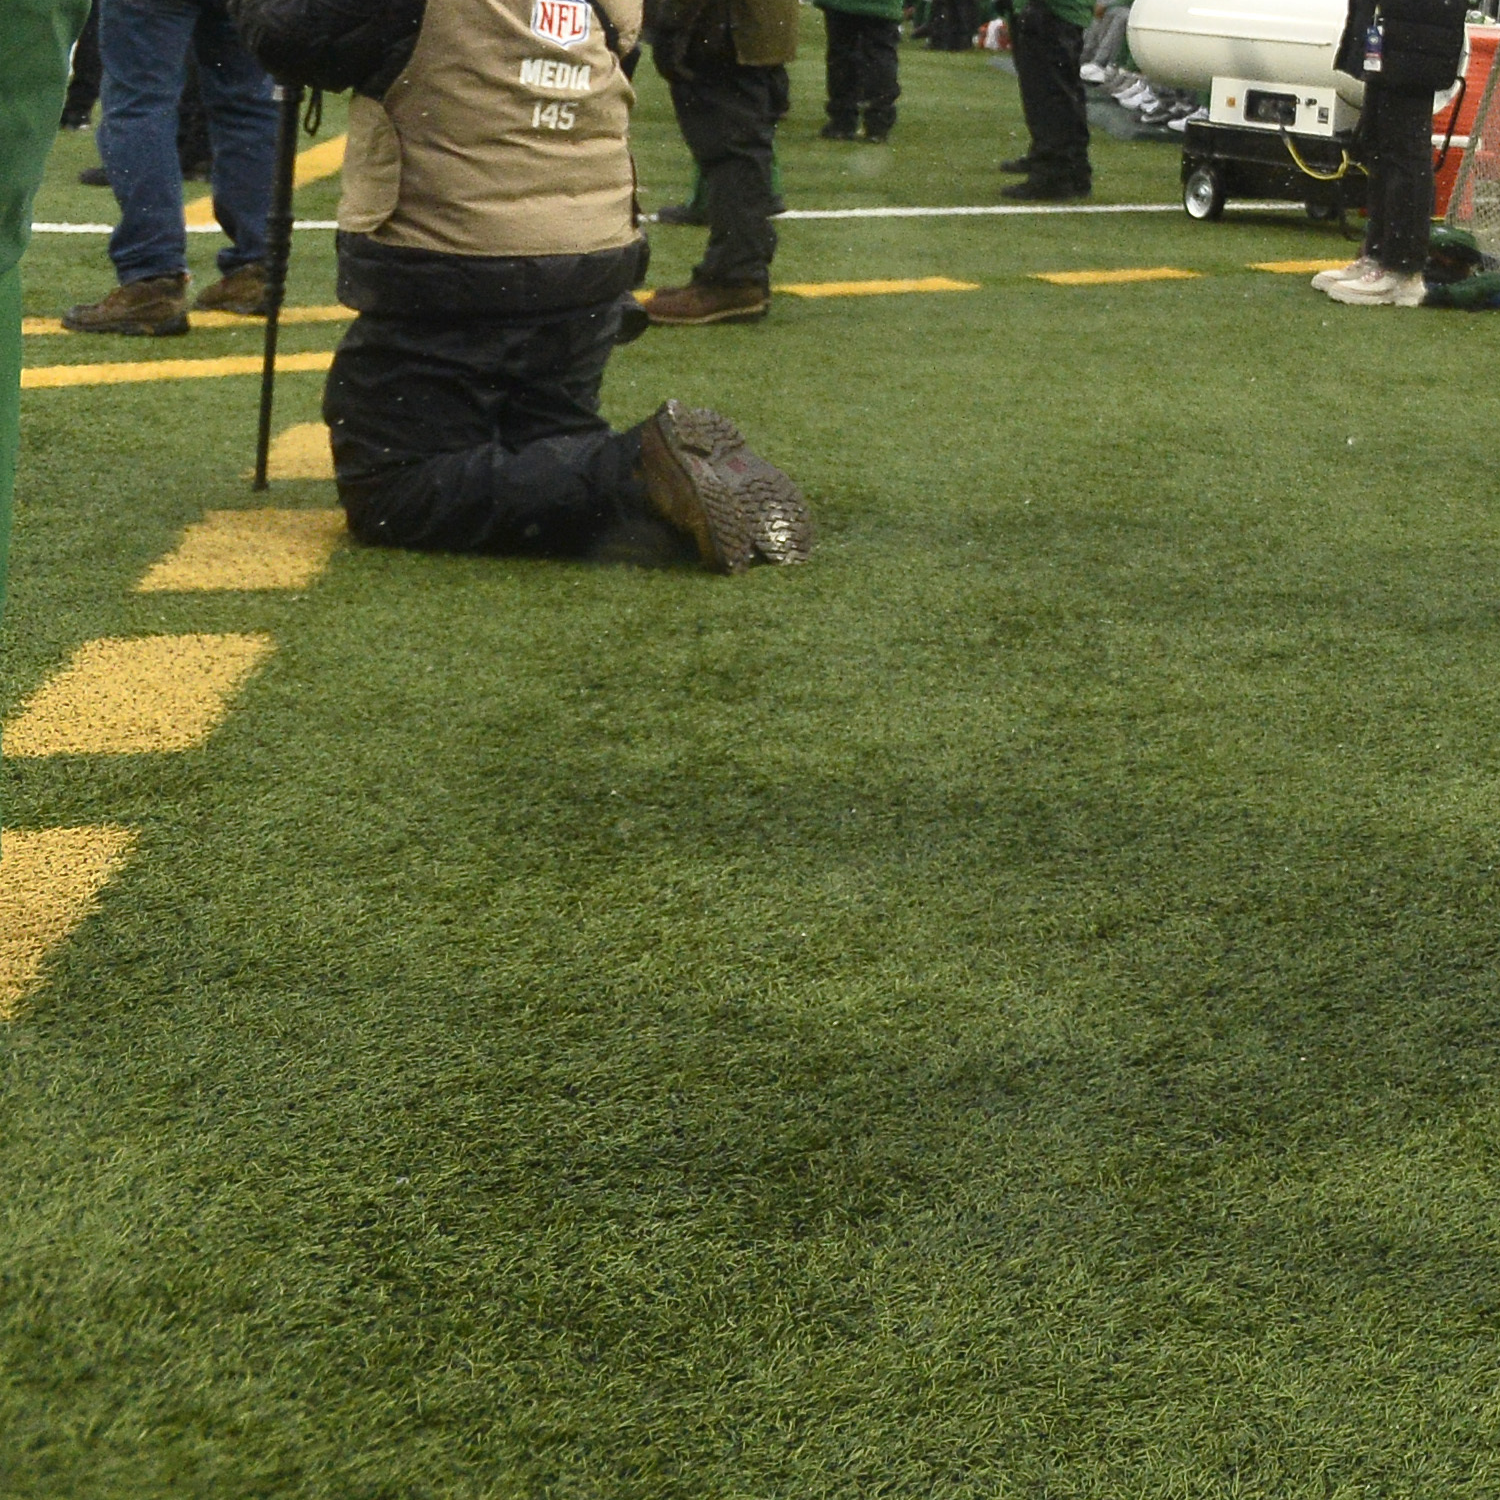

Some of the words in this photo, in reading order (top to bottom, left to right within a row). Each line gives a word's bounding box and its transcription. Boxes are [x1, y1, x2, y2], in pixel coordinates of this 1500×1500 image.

[540, 2, 582, 38] NFL
[519, 58, 591, 90] MEDIA
[532, 101, 578, 130] 145
